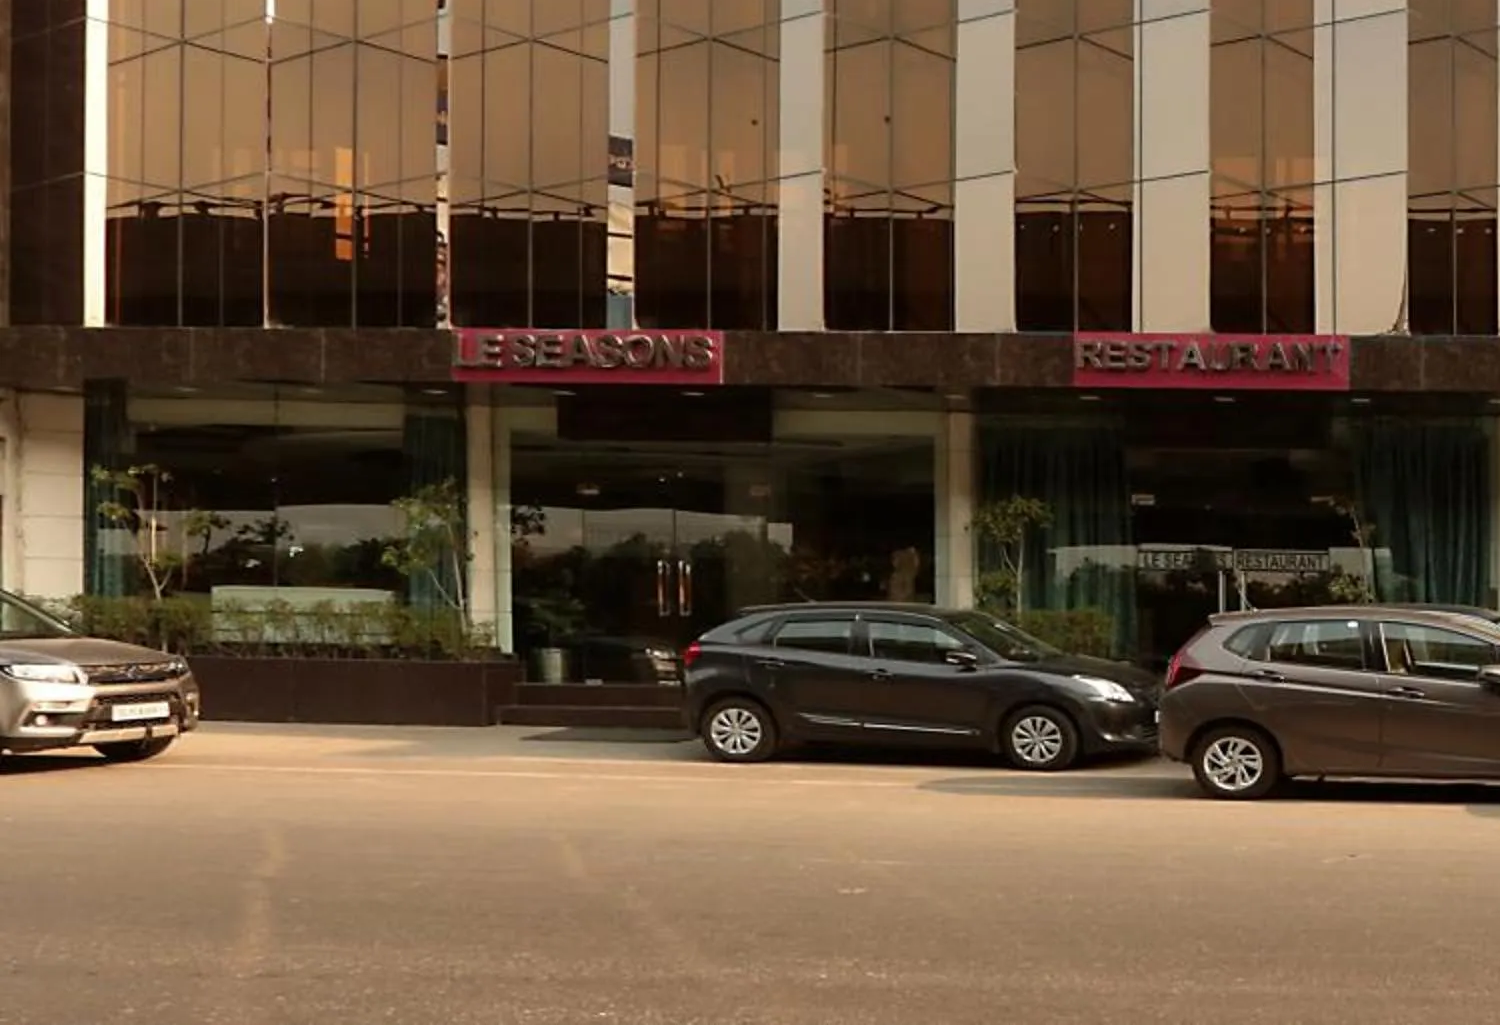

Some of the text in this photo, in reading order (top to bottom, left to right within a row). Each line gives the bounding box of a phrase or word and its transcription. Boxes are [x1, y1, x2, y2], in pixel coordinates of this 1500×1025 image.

[453, 332, 713, 370] LE SEASONS
[1076, 338, 1343, 372] RESTAURANT
[1163, 552, 1229, 570] SEAS
